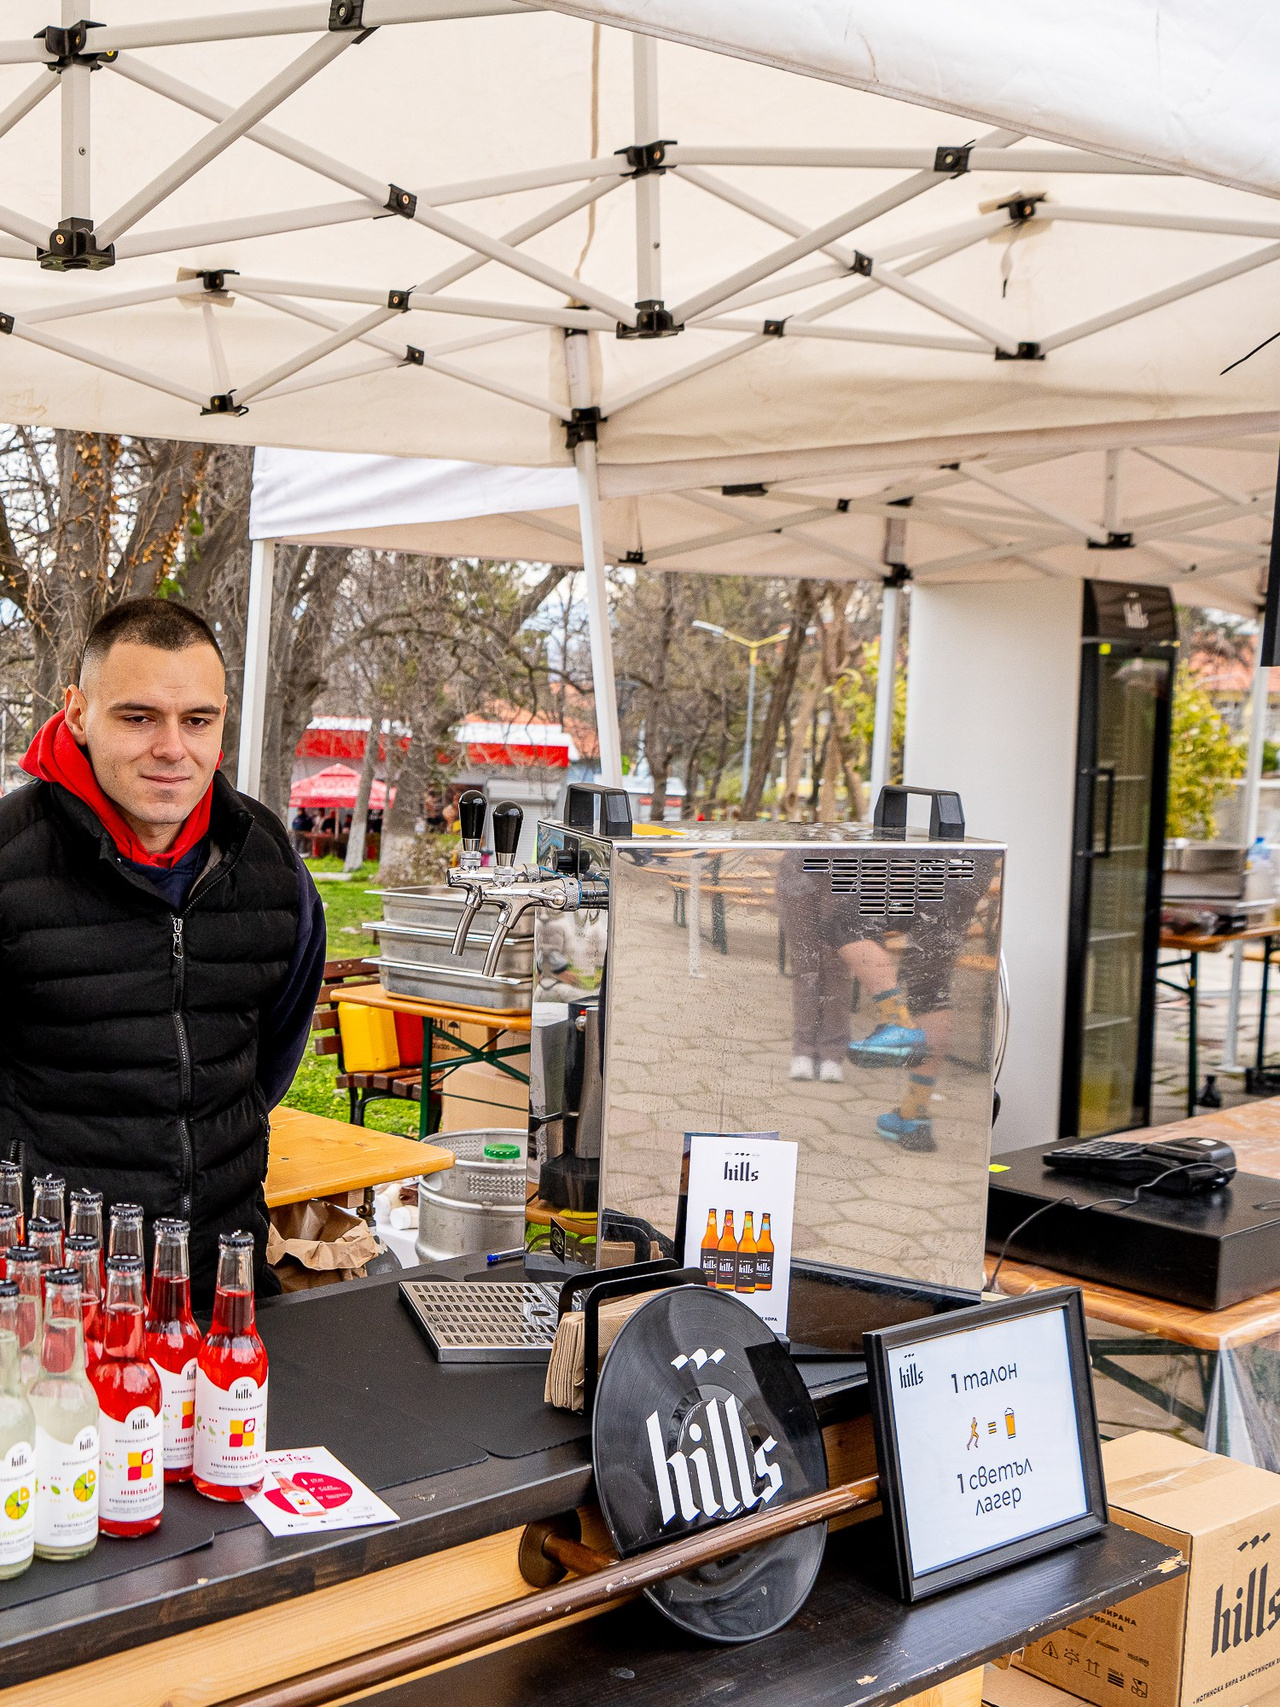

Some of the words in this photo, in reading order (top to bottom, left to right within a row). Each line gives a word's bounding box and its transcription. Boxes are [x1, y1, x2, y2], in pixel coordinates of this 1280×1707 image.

[724, 1161, 759, 1182] hills
[899, 1363, 924, 1389] hills
[951, 1373, 959, 1393] 1
[964, 1363, 1018, 1391] талон
[235, 1389, 252, 1399] hills
[132, 1418, 150, 1430] hills
[79, 1438, 94, 1451] hills
[11, 1455, 28, 1467] hills
[646, 1393, 783, 1526] hills
[957, 1473, 965, 1493] 1
[969, 1458, 1033, 1490] светъл
[975, 1487, 1022, 1516] лагер
[1210, 1562, 1280, 1659] hills
